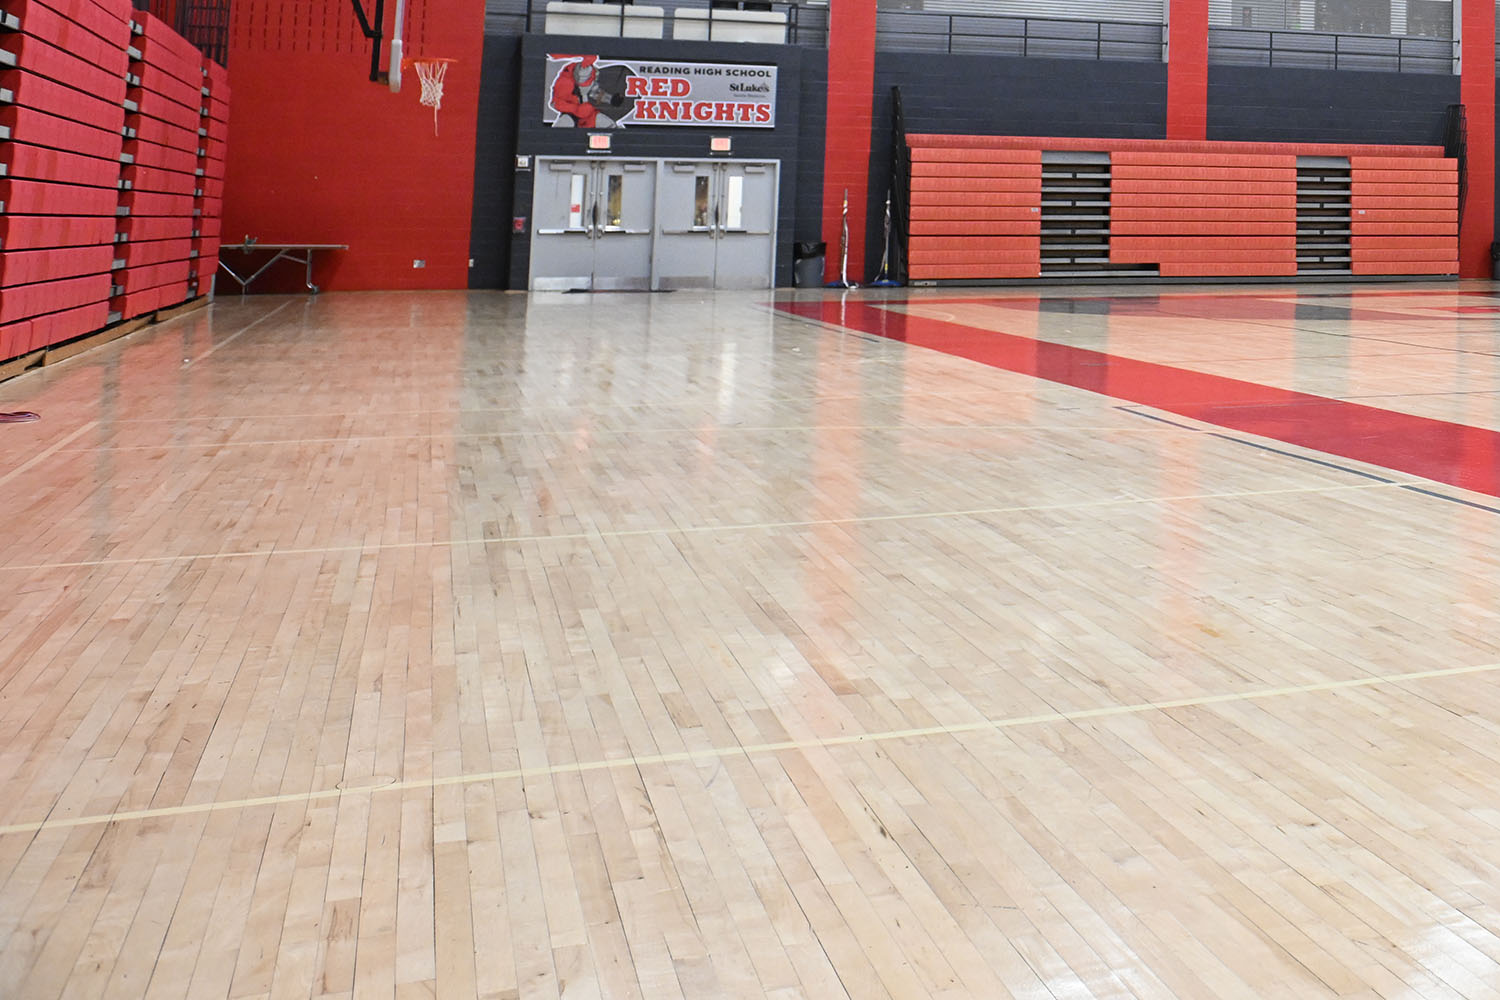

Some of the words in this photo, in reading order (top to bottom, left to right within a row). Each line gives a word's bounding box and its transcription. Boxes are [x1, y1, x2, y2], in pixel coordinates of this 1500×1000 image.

[639, 66, 691, 75] READING
[694, 68, 722, 76] HIGH
[726, 69, 772, 78] SCHOOL
[626, 76, 691, 97] RED
[634, 100, 771, 122] KNIGHTS
